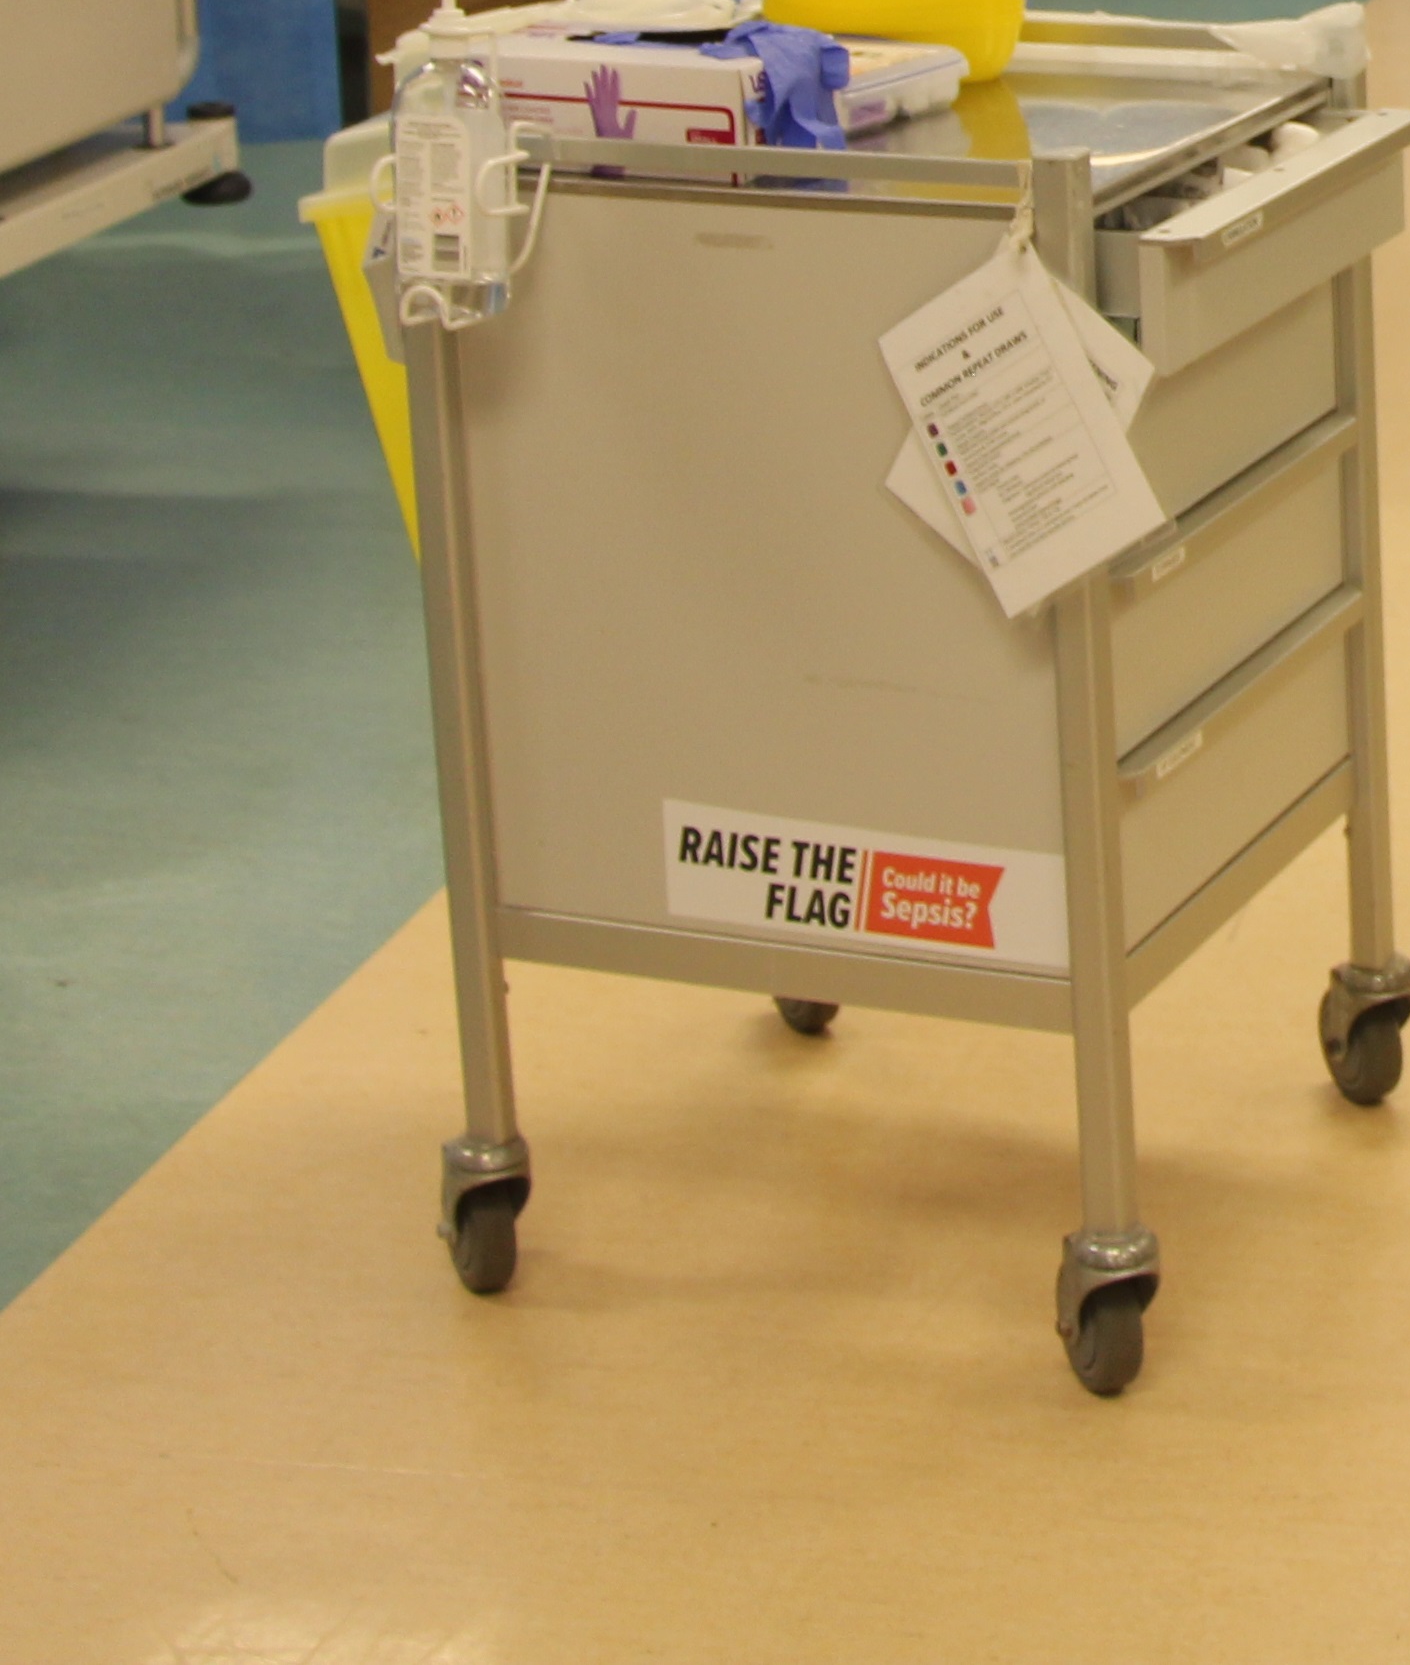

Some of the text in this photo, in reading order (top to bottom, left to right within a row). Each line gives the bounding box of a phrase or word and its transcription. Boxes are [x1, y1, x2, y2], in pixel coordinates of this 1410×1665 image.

[913, 306, 1005, 373] INDICATIONS FOR USE
[961, 349, 971, 360] &
[920, 330, 1028, 408] COMMON REPEAT DRAWS
[678, 825, 857, 885] RAISE THE
[764, 883, 852, 929] FLAG
[882, 866, 981, 900] Could it be
[880, 891, 978, 930] Sepsis?
